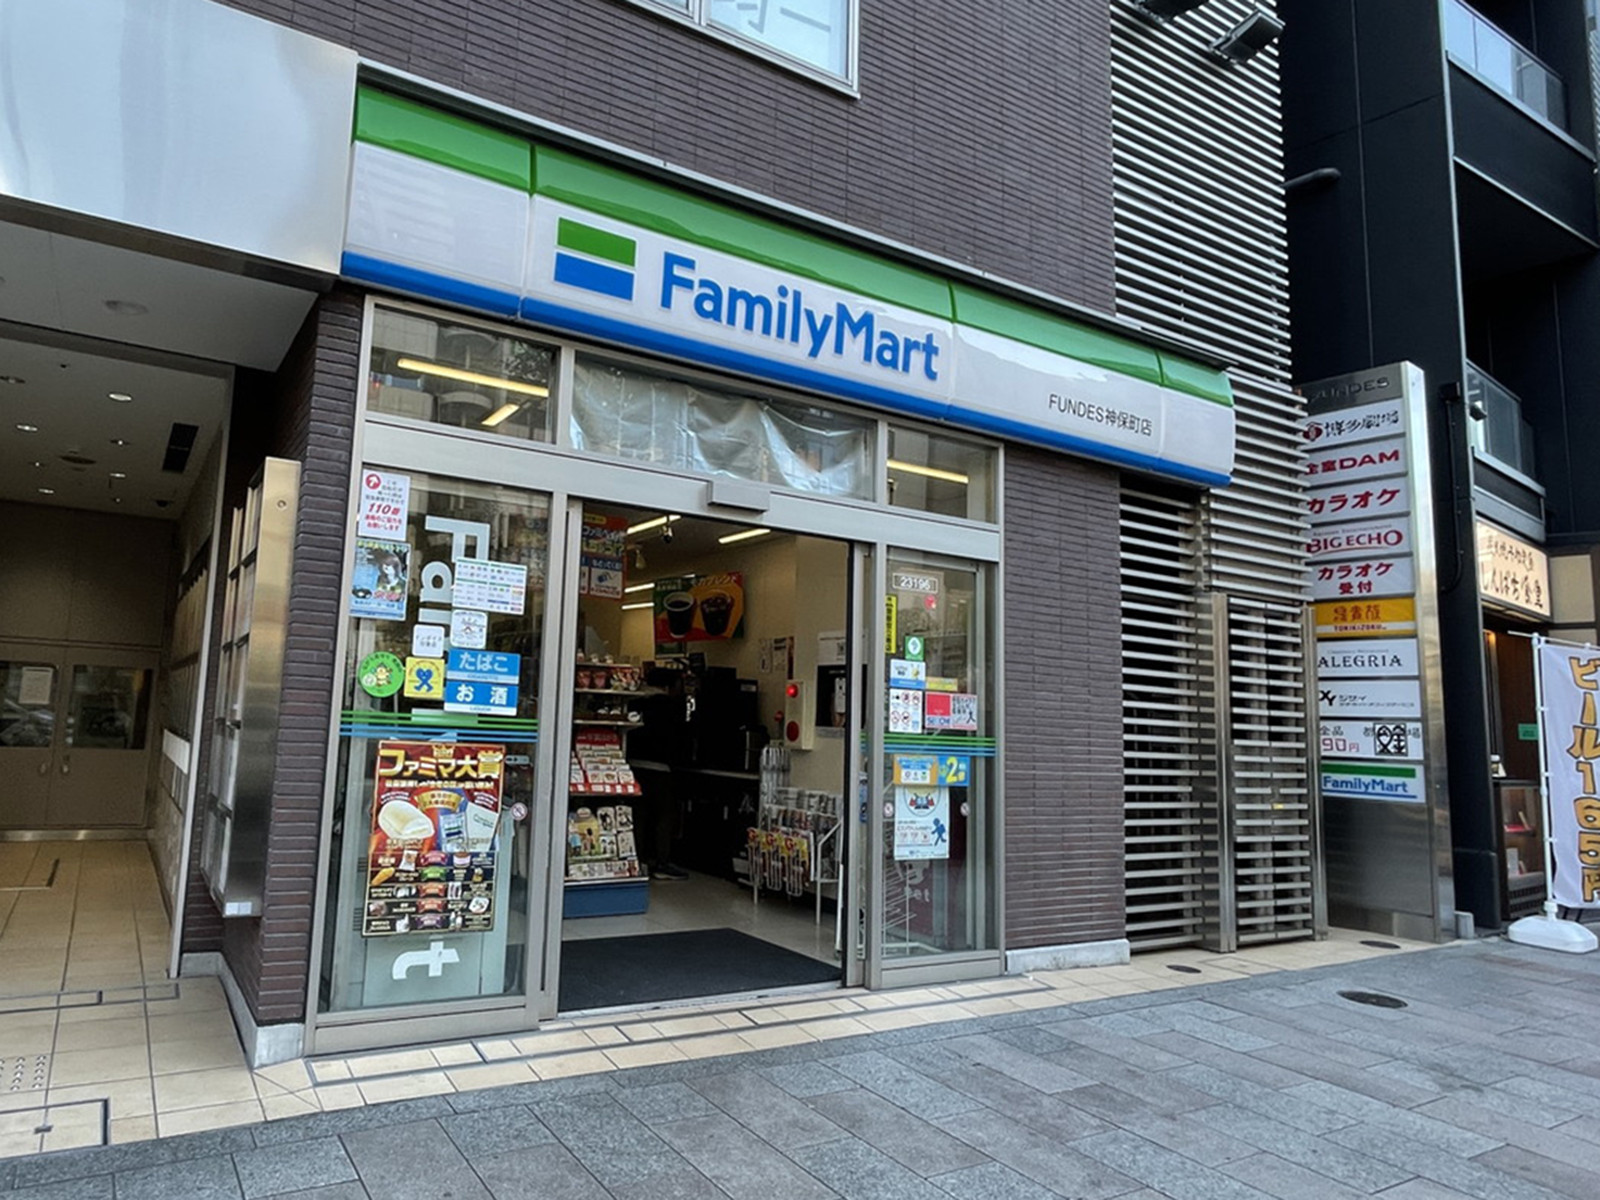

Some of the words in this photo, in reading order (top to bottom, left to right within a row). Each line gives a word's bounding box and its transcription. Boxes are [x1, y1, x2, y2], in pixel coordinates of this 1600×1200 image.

[660, 251, 940, 381] FamilyMart
[1048, 393, 1153, 437] FUNDES神保町店
[1307, 489, 1400, 514] カラオケ
[1306, 537, 1342, 554] BIG
[1346, 529, 1403, 547] ECHO
[1318, 562, 1394, 581] カラオケ
[1339, 580, 1373, 595] 受付
[1333, 604, 1381, 622] 鳥貴族
[459, 652, 509, 672] たばこ
[1318, 654, 1402, 668] ALEGRIA
[379, 748, 504, 778] ファミマ大賞
[1323, 776, 1408, 793] FamilyMart
